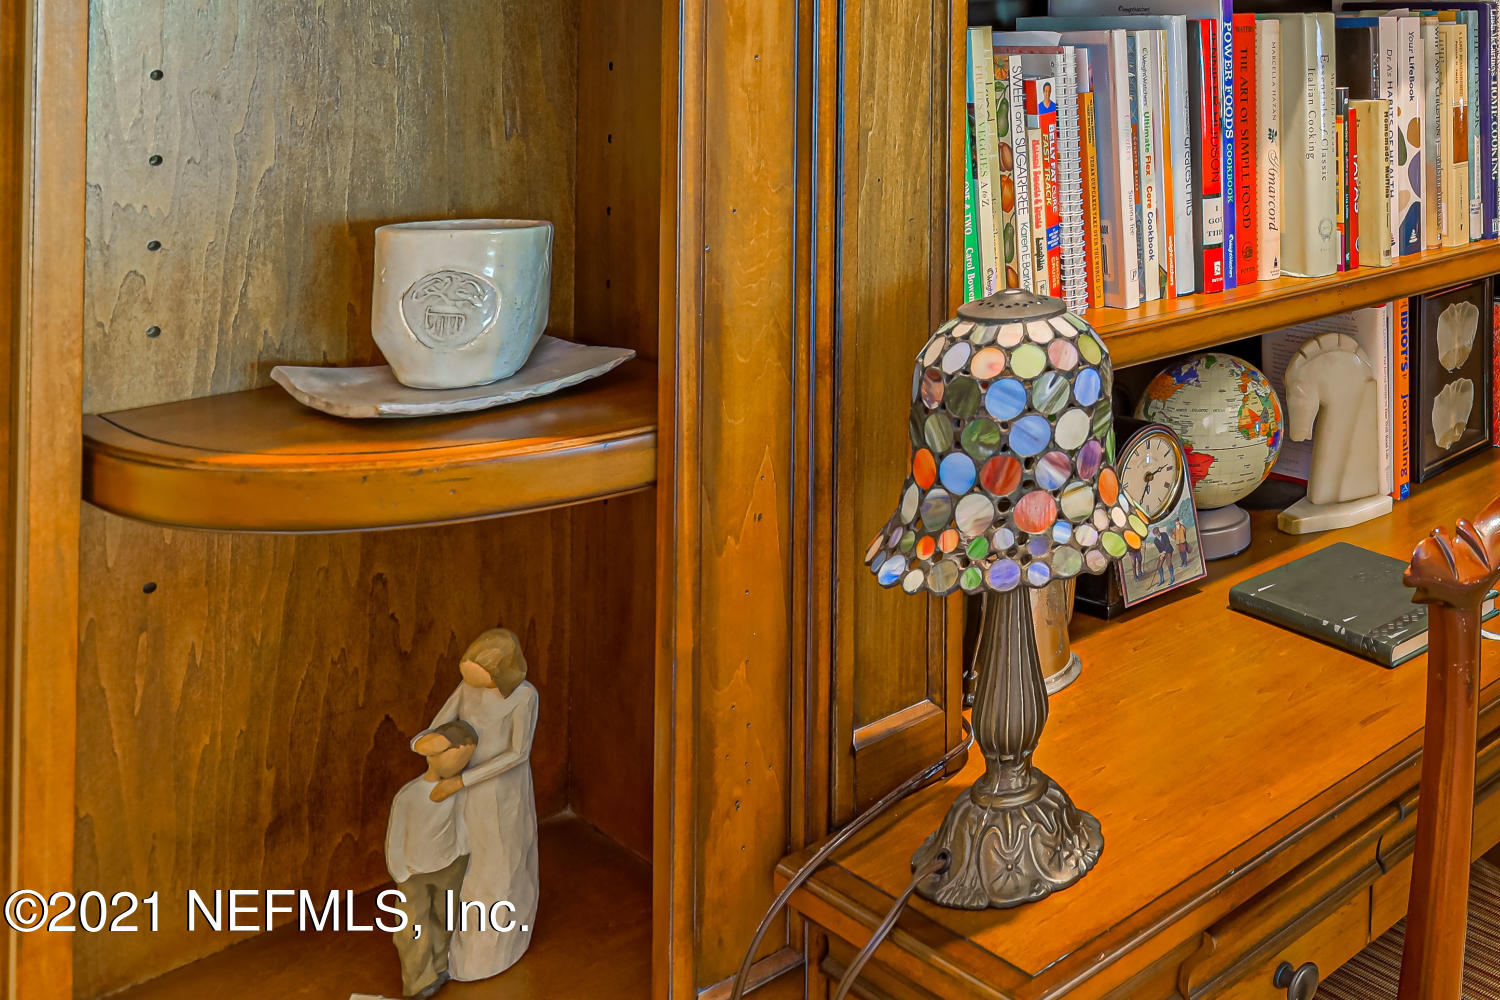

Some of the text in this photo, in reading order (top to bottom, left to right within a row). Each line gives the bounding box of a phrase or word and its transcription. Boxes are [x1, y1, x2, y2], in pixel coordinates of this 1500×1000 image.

[1223, 21, 1234, 204] POWER FOODS COOKBOOK
[1306, 67, 1317, 160] Italian Cooking
[1489, 9, 1499, 180] Linda McCartney's HOME COOKING
[1049, 124, 1057, 161] BELLY
[1145, 155, 1153, 176] Flex
[1240, 49, 1251, 229] THE ART OF SIMPLE FOOD
[1044, 168, 1052, 206] TRACK
[1146, 186, 1154, 209] Core
[1147, 212, 1155, 262] Cookbook
[1400, 310, 1409, 477] IDIOT'S Journaling
